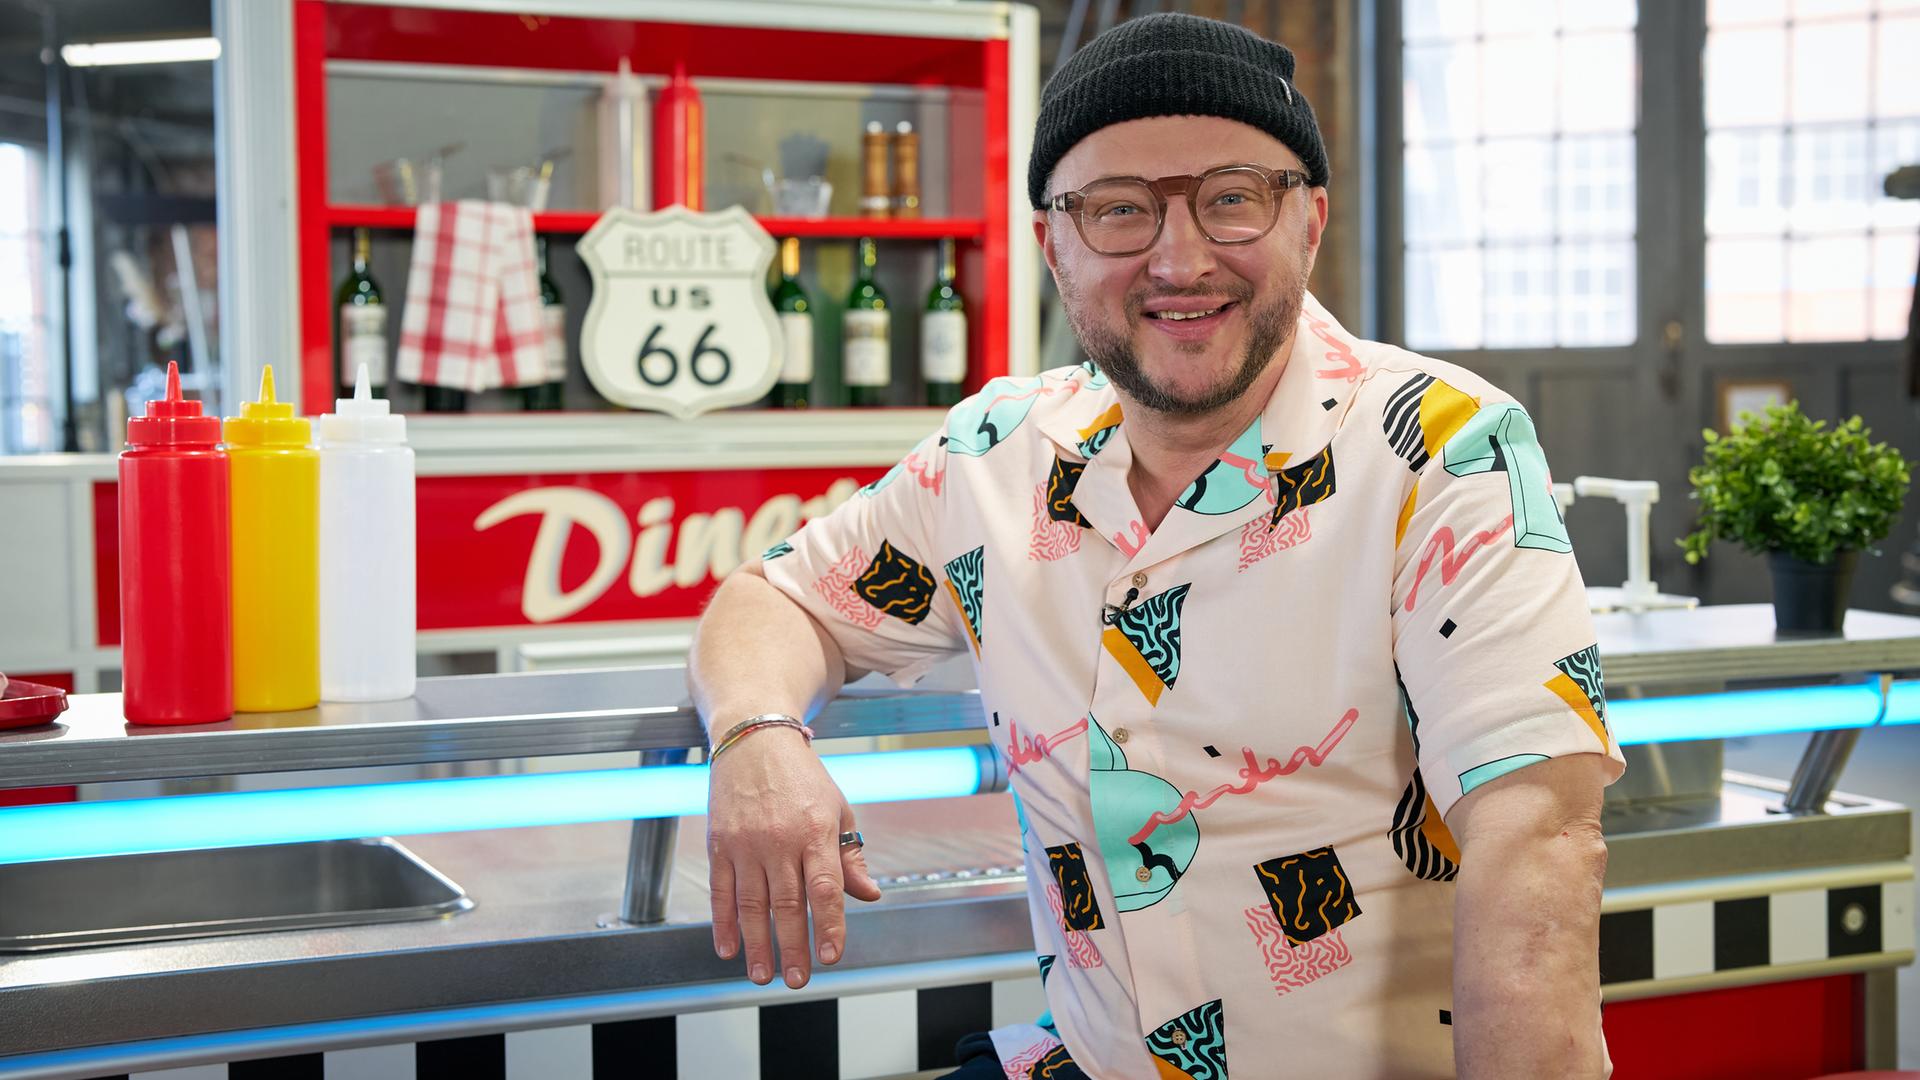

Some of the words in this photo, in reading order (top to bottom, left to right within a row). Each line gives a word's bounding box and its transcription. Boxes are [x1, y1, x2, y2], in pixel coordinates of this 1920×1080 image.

[623, 235, 736, 267] ROUTE
[652, 285, 711, 310] US
[637, 323, 732, 387] 66
